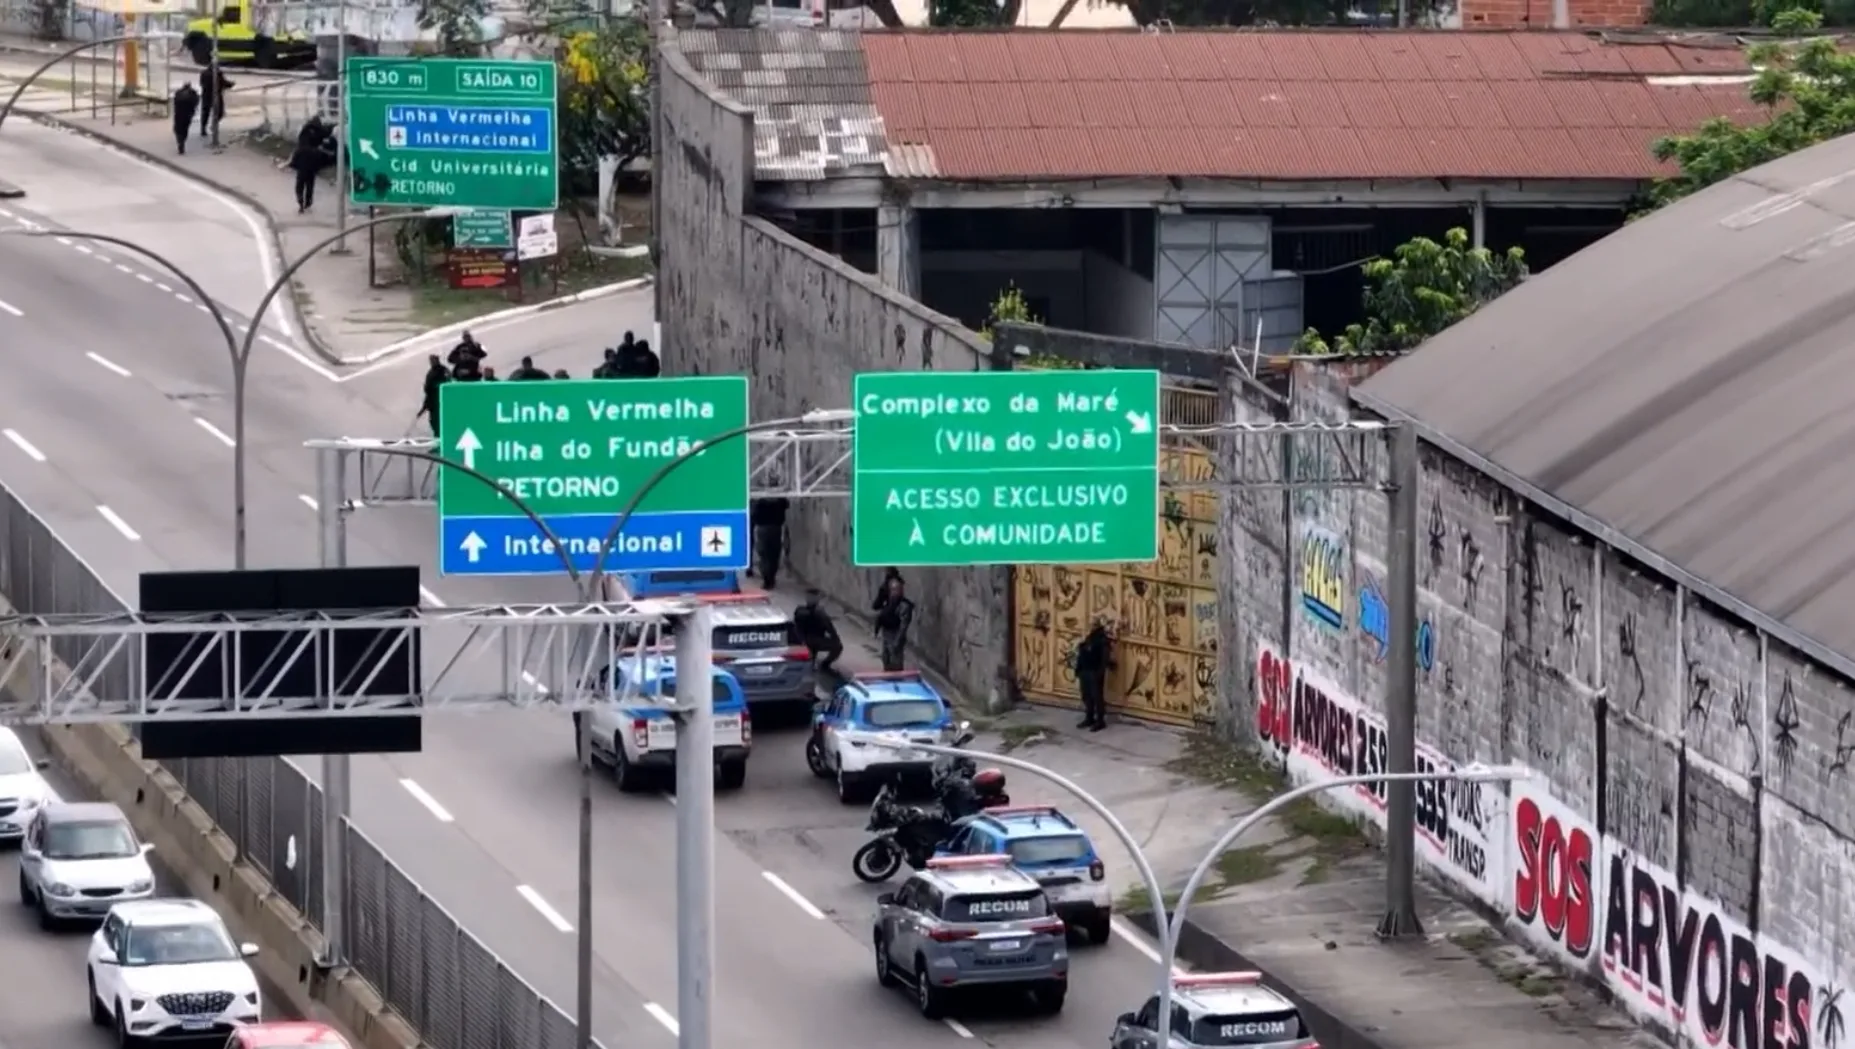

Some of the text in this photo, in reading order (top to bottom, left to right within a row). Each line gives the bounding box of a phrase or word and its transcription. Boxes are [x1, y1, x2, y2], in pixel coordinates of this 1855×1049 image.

[366, 71, 422, 86] 830 m
[462, 69, 538, 88] SAÍDA 10
[389, 108, 533, 125] Linha Vermelha
[416, 131, 537, 147] Internacional
[390, 158, 549, 176] Cid Universitária
[390, 179, 456, 195] RETORNO
[496, 399, 715, 423] Linha Vermelha
[862, 387, 1119, 418] Complexo da Maré
[496, 436, 707, 461] Ilha do Fundão
[935, 427, 1122, 455] (Vila do João)
[497, 476, 620, 499] RETORNO
[886, 484, 1128, 510] ACESSO EXCLUSIVO
[908, 518, 1106, 546] À COMUNIDADE
[968, 900, 1030, 916] RECOM
[1516, 797, 1813, 1049] SOS ÁRVORES
[1220, 1021, 1286, 1037] RECOM
